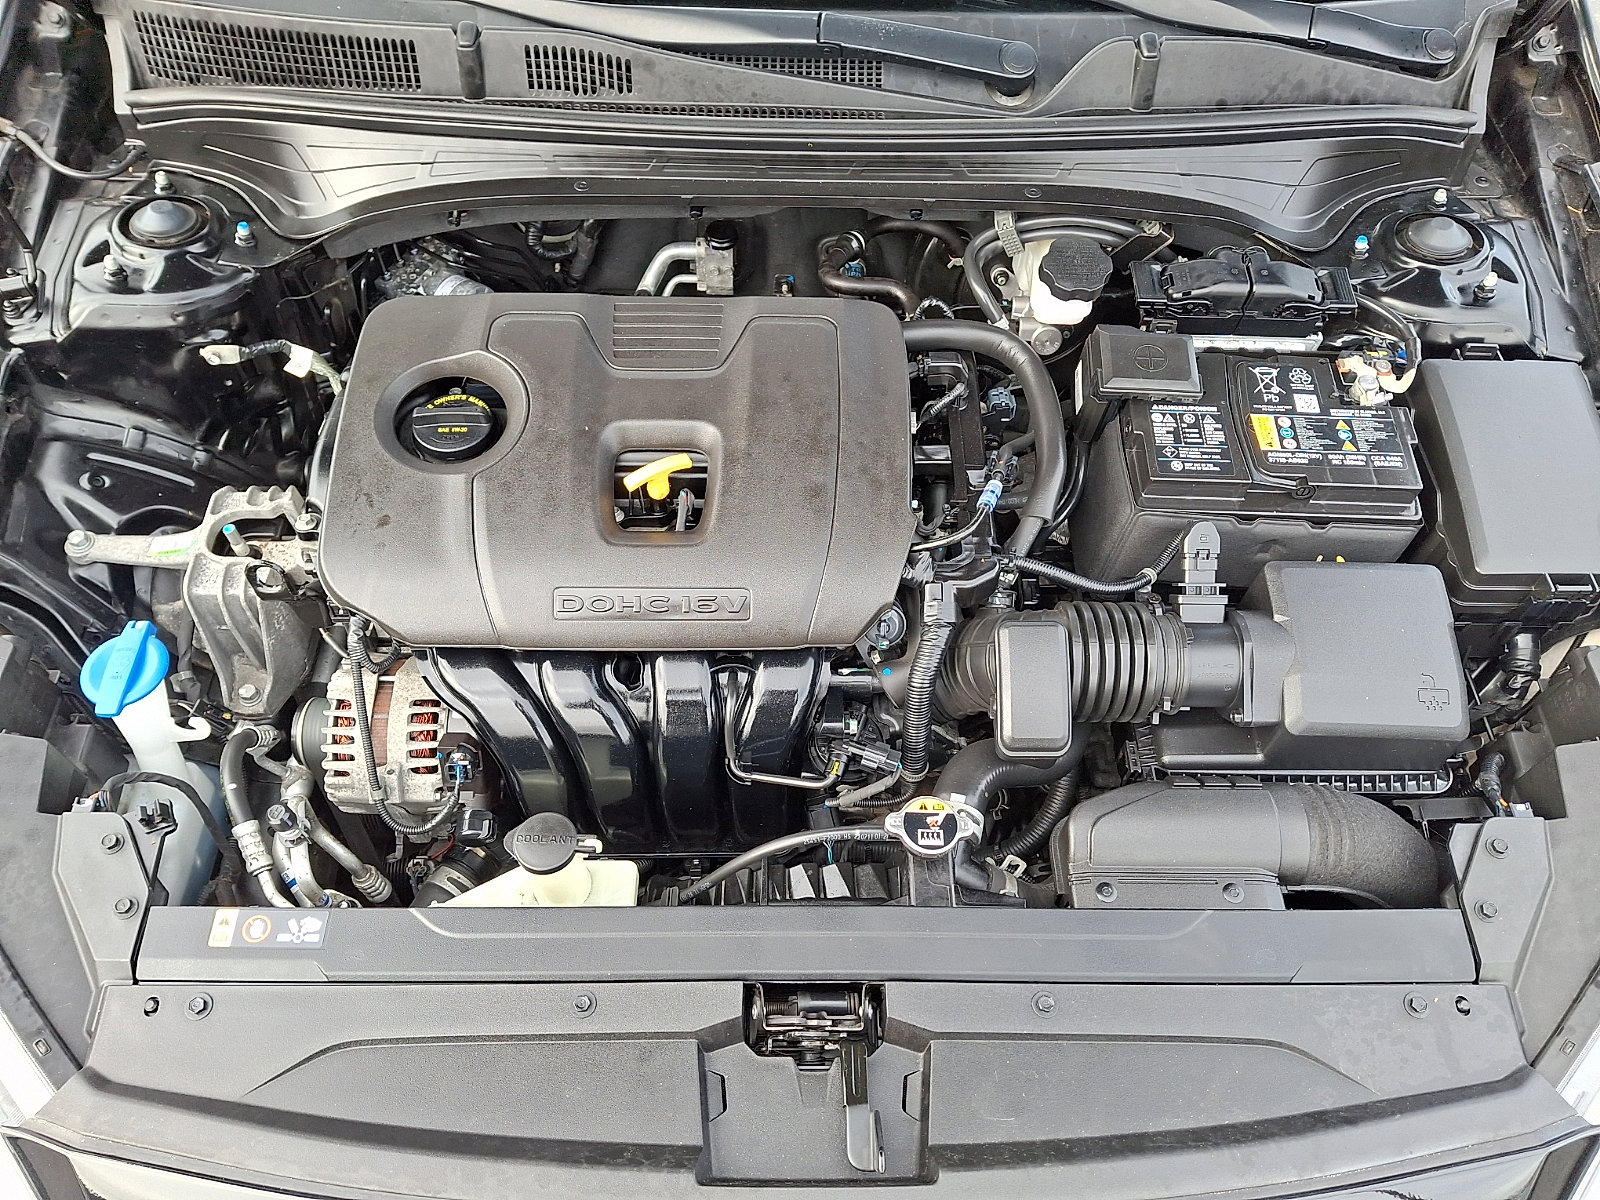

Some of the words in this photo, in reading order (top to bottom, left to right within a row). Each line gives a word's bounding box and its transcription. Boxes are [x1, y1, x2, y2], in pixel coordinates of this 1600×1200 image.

[1263, 393, 1280, 403] Pb
[557, 595, 670, 613] DOHC
[680, 595, 748, 613] 16V
[516, 834, 576, 846] COOLANT
